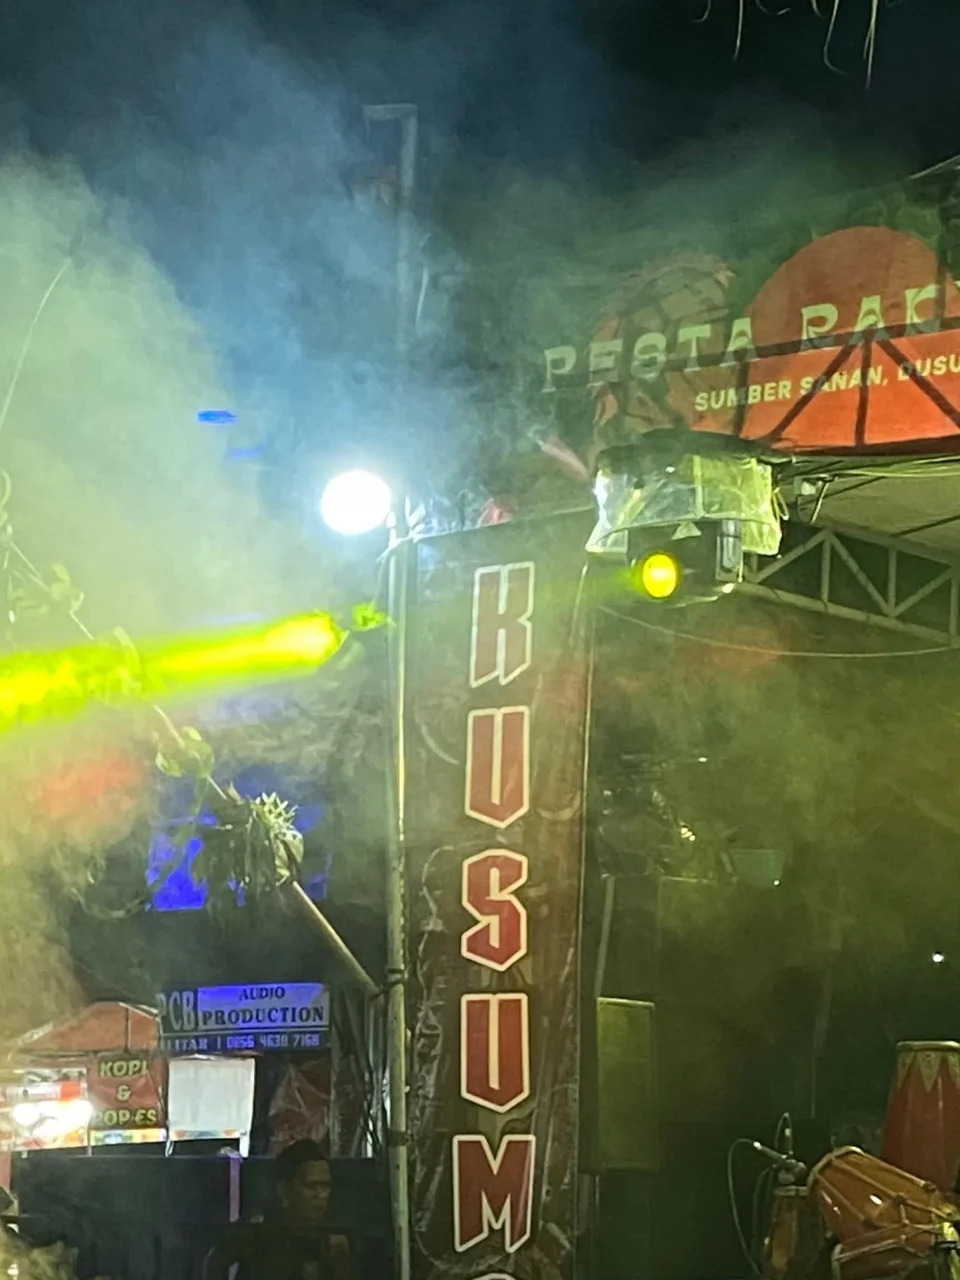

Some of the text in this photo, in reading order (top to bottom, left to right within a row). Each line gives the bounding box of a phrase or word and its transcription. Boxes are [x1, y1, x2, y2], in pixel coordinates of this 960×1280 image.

[543, 280, 960, 393] PESTA RAK
[695, 379, 792, 411] SUMBER
[239, 986, 286, 1001] AUDIO
[202, 1006, 324, 1026] PRODUCTION
[99, 1059, 148, 1077] KOPI
[117, 1084, 132, 1101] &
